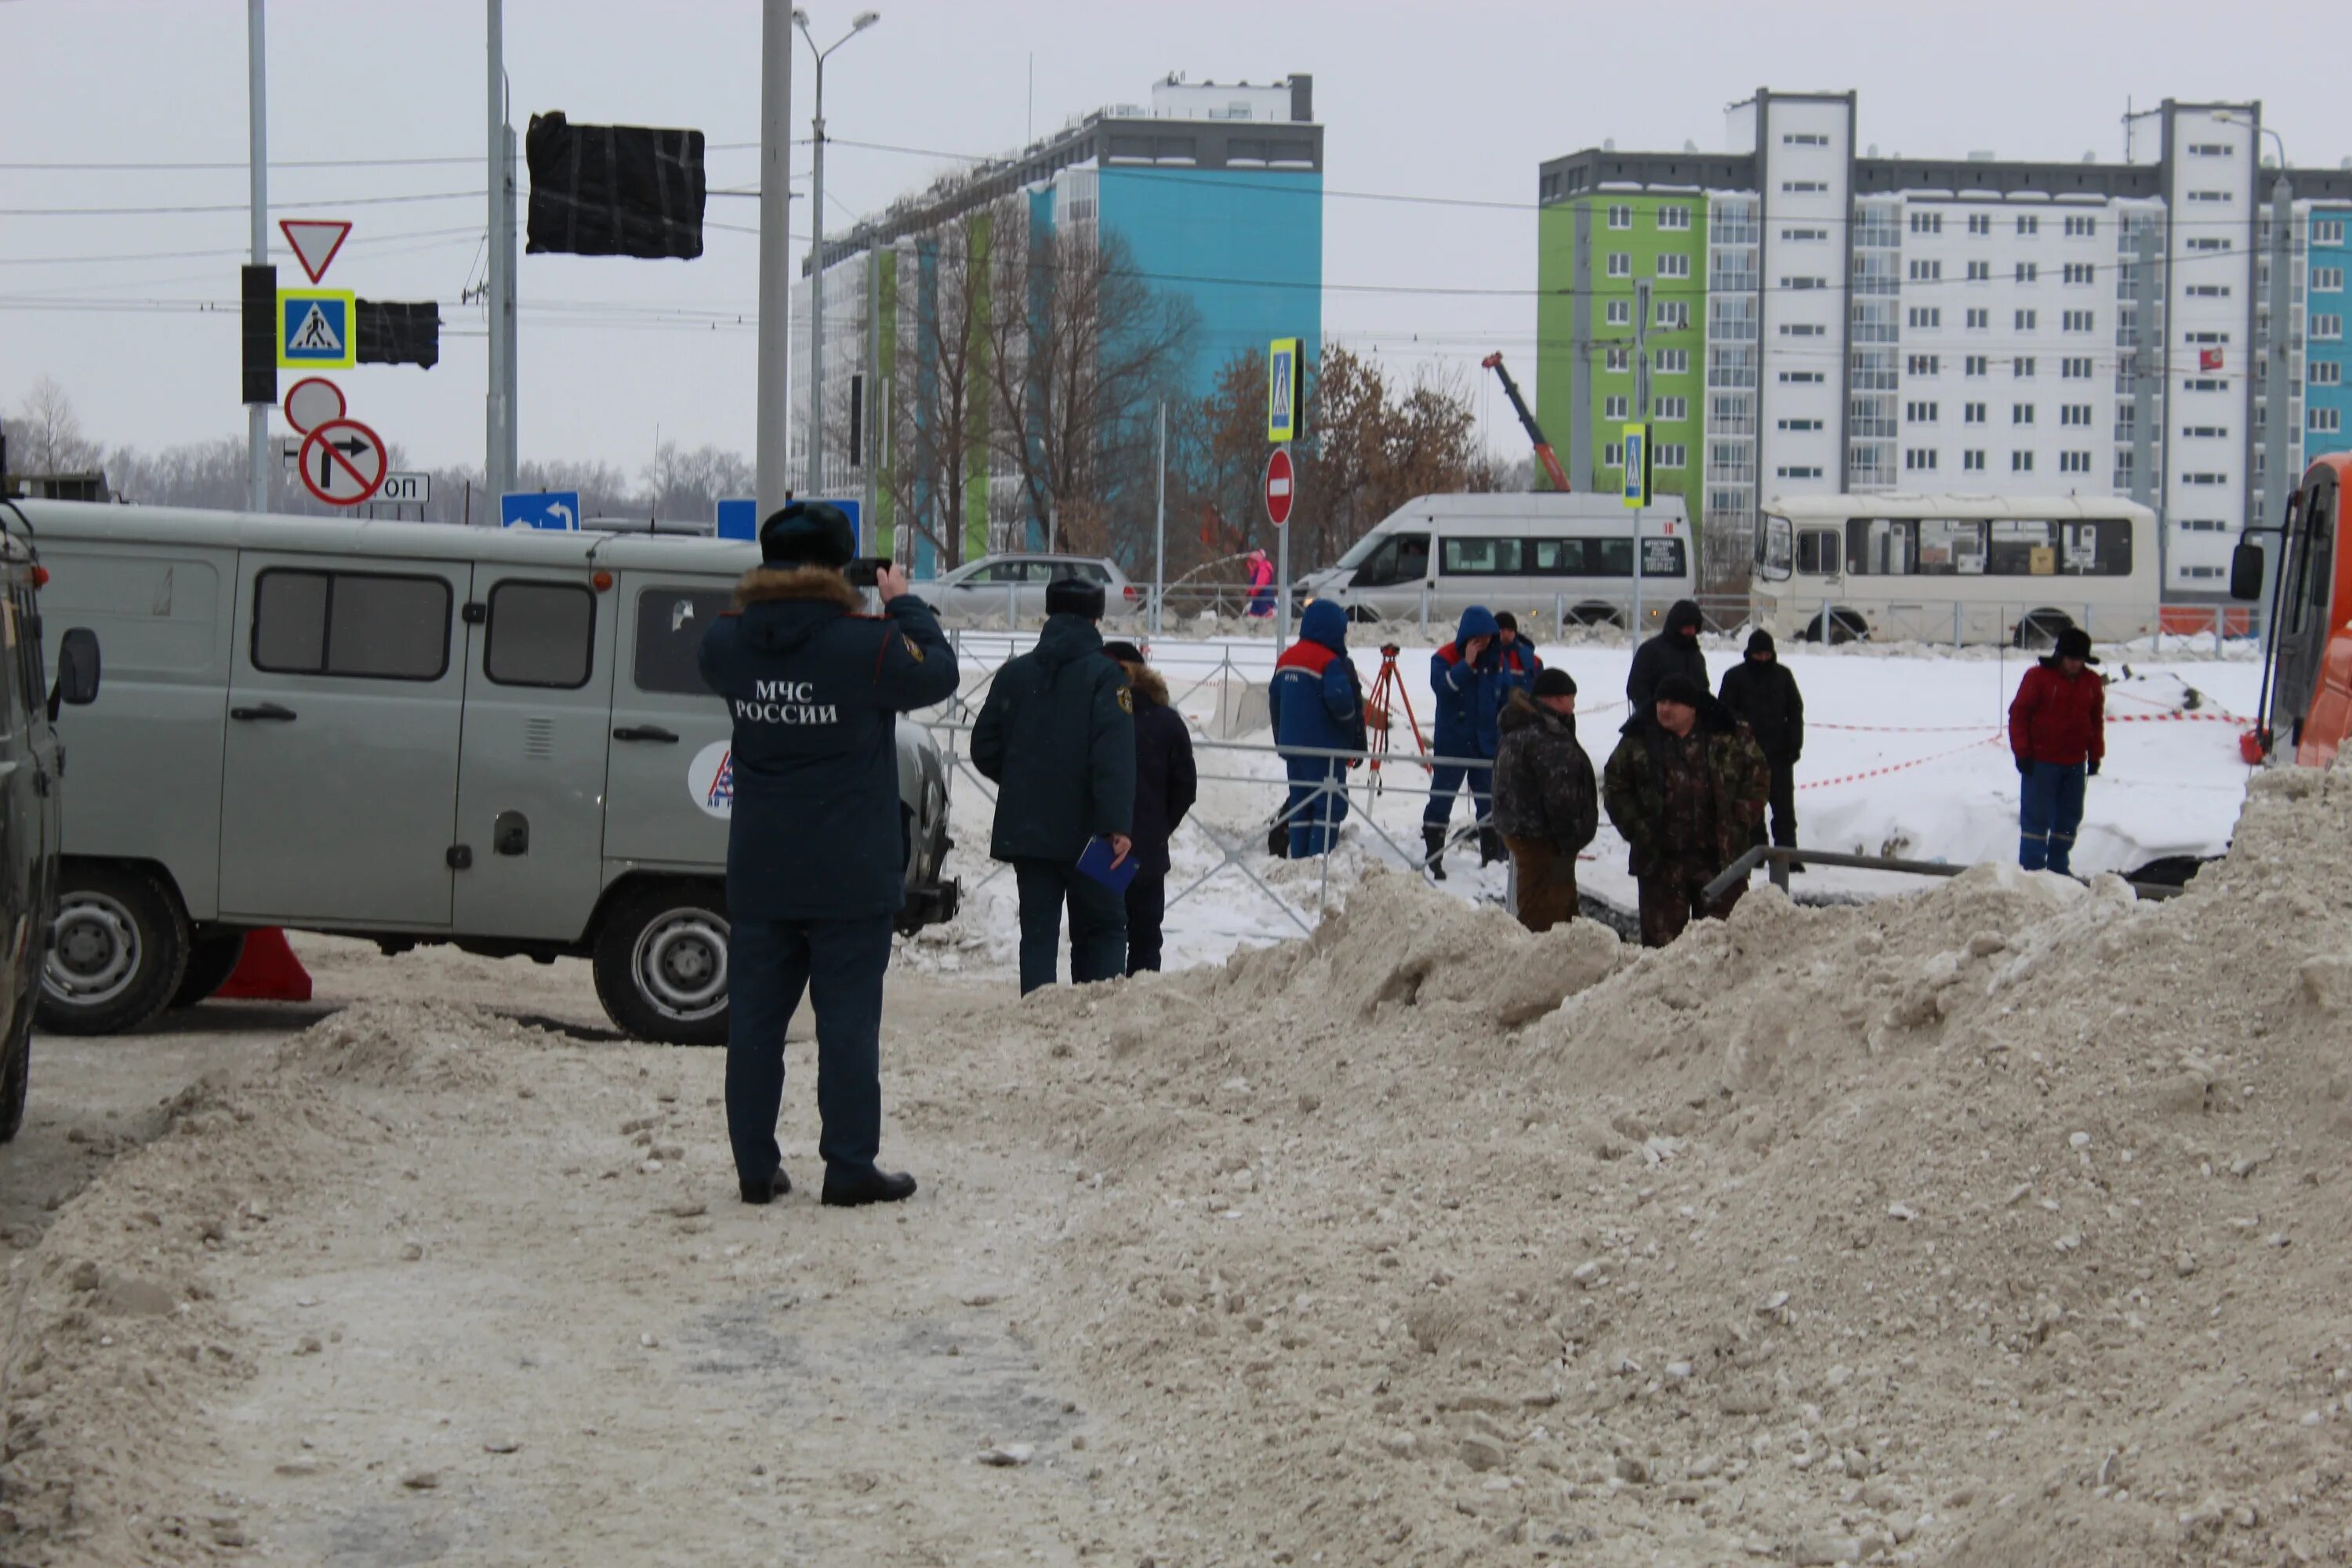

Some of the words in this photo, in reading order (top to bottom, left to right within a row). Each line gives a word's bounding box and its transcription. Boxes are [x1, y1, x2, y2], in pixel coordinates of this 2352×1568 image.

[375, 477, 416, 498] ОП
[756, 680, 813, 703] МЧС
[736, 699, 837, 724] РОССИИ
